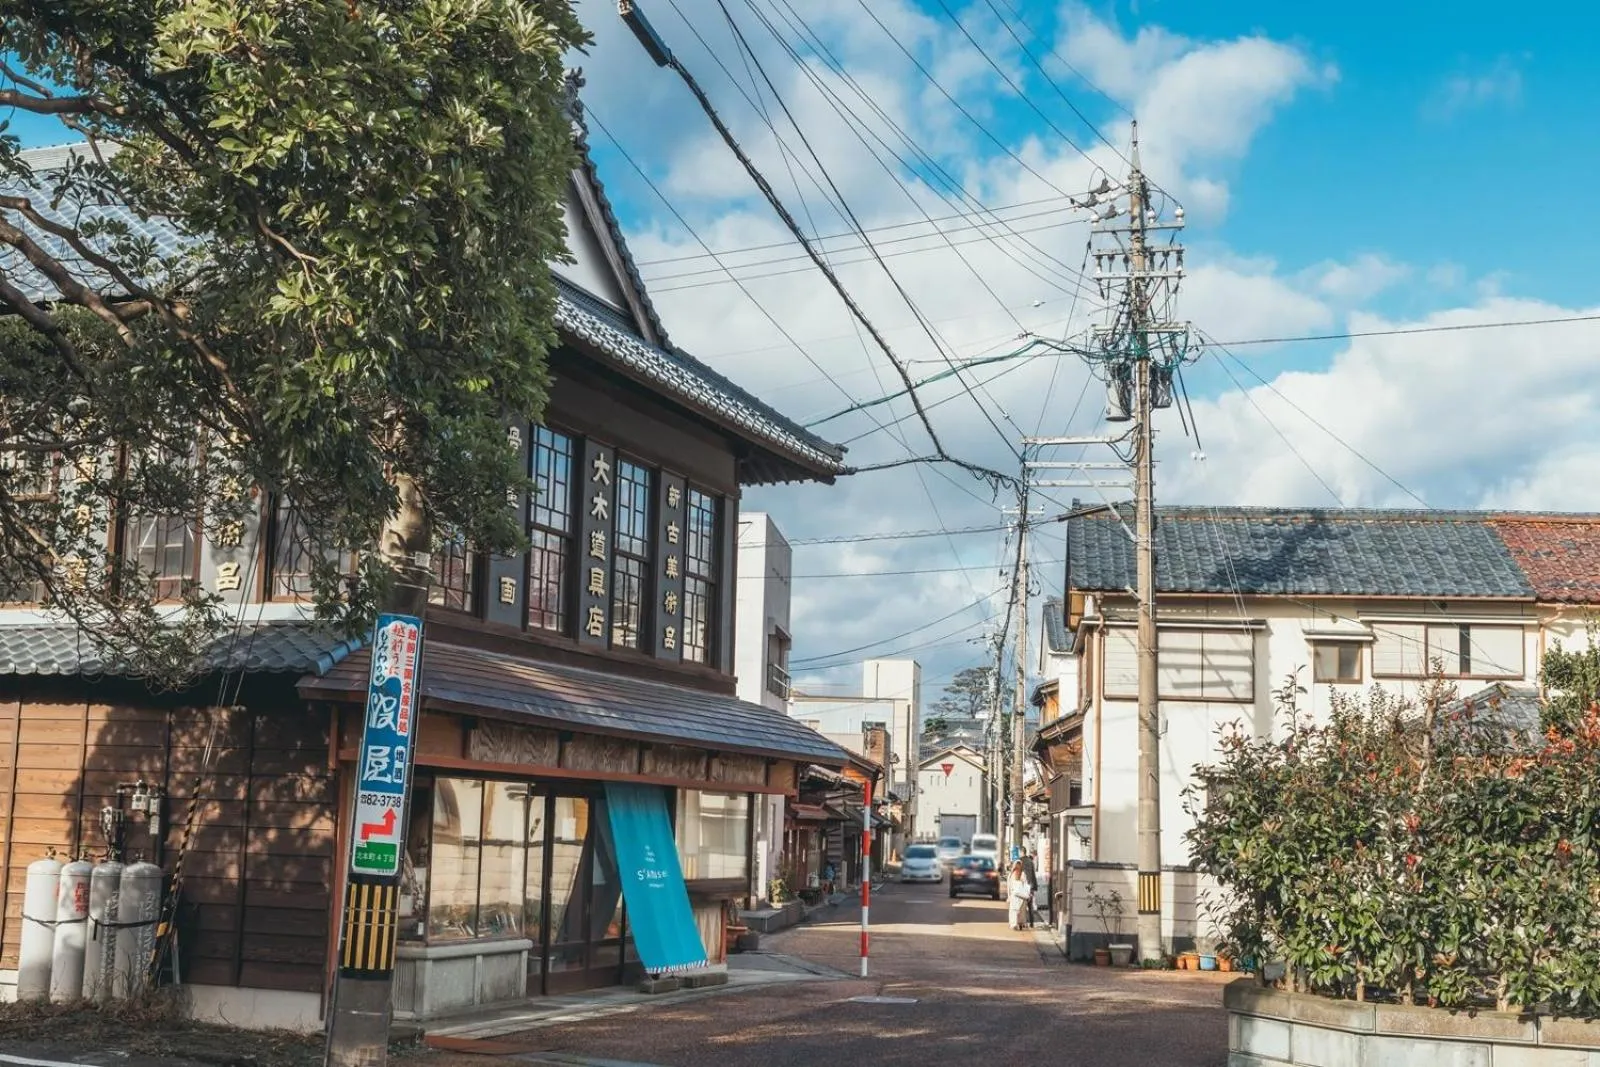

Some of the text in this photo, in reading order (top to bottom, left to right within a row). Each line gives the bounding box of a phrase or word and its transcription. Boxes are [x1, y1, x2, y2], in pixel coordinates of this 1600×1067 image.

[586, 452, 610, 637] 大木道具店
[663, 484, 680, 650] 新古美術品
